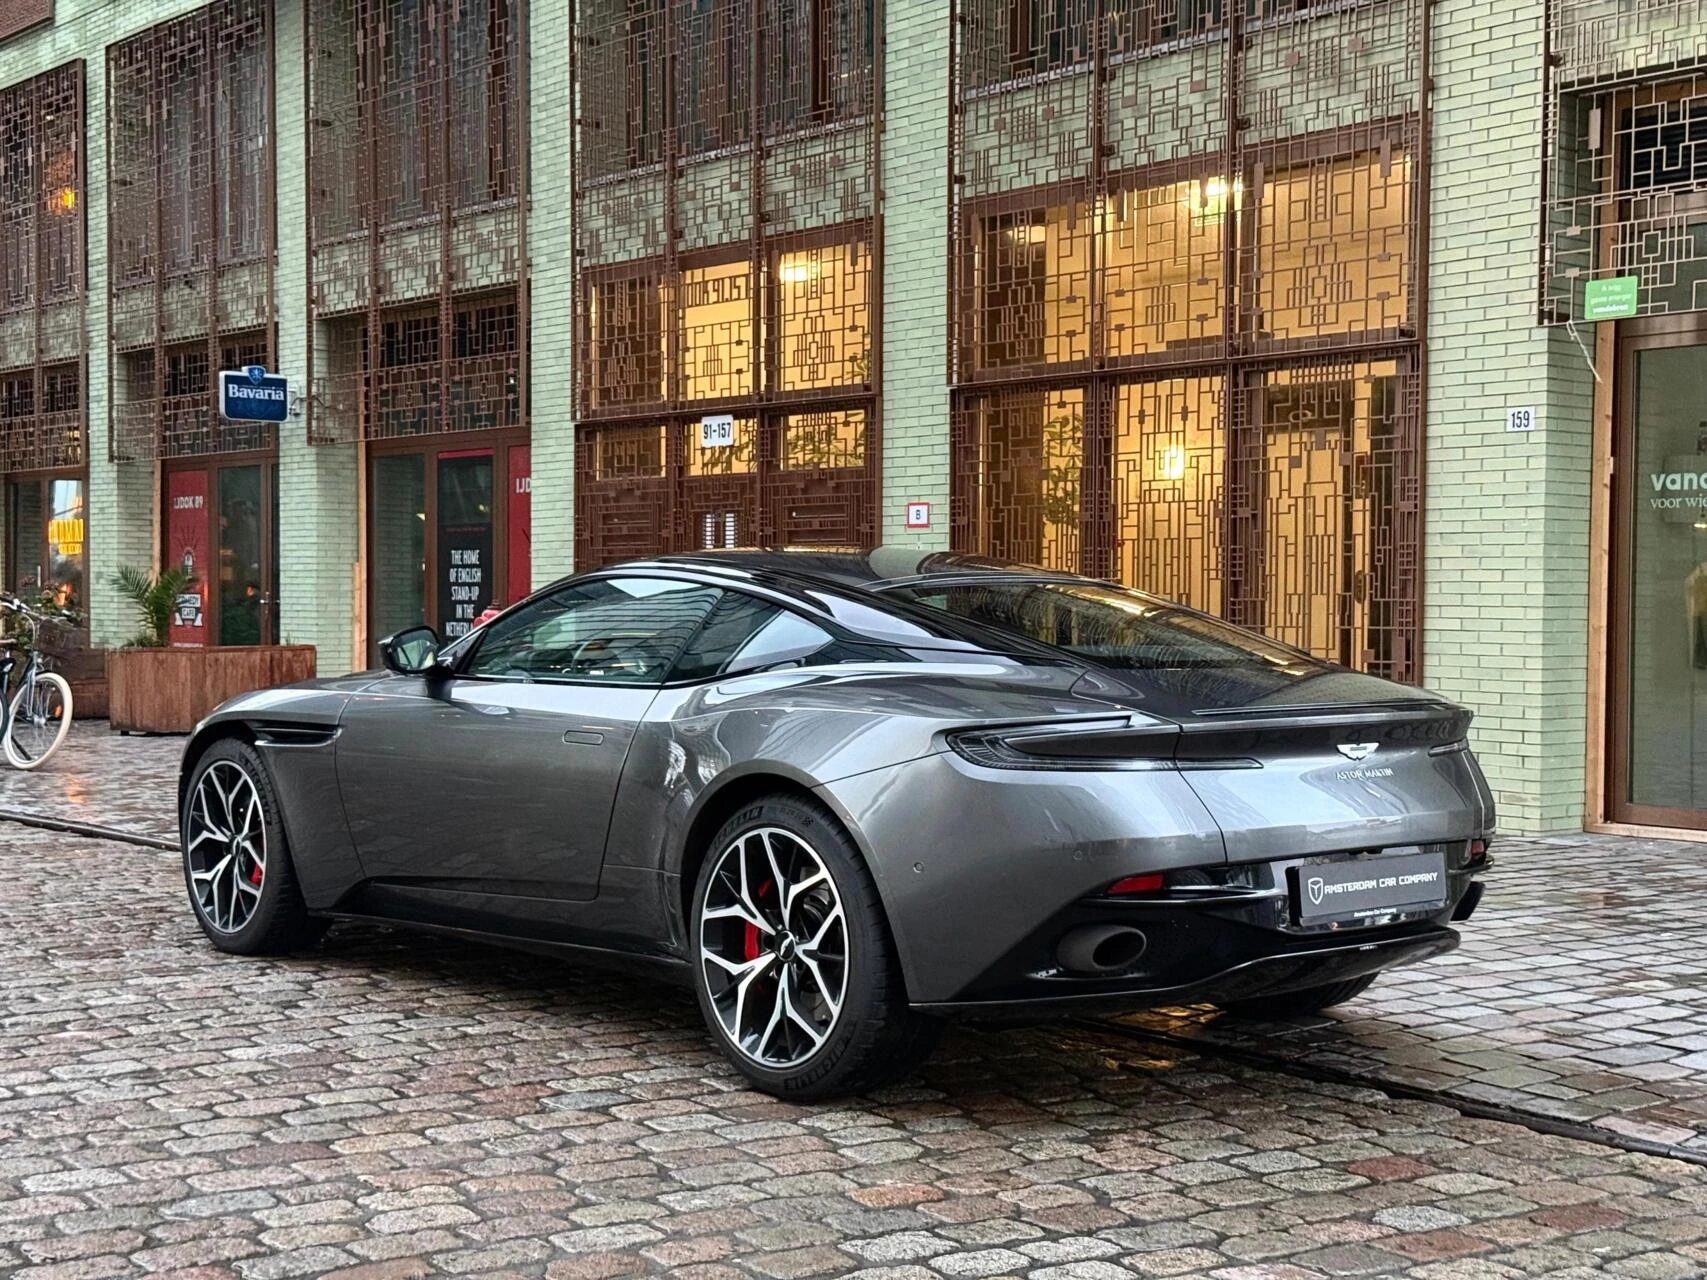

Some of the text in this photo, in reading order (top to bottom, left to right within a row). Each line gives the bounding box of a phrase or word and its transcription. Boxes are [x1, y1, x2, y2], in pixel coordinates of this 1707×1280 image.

[228, 384, 285, 400] Bavaria
[1511, 410, 1530, 428] 159
[703, 422, 731, 439] 91-157
[1650, 498, 1682, 509] voor
[451, 550, 480, 564] THE HOME
[450, 568, 481, 582] OF ENGLISH
[451, 586, 480, 600] STAND-UP
[456, 604, 475, 618] IN THE
[1337, 768, 1394, 780] ASTON MARTIN
[1324, 872, 1438, 895] AMSTERDAM CAR COMPANY
